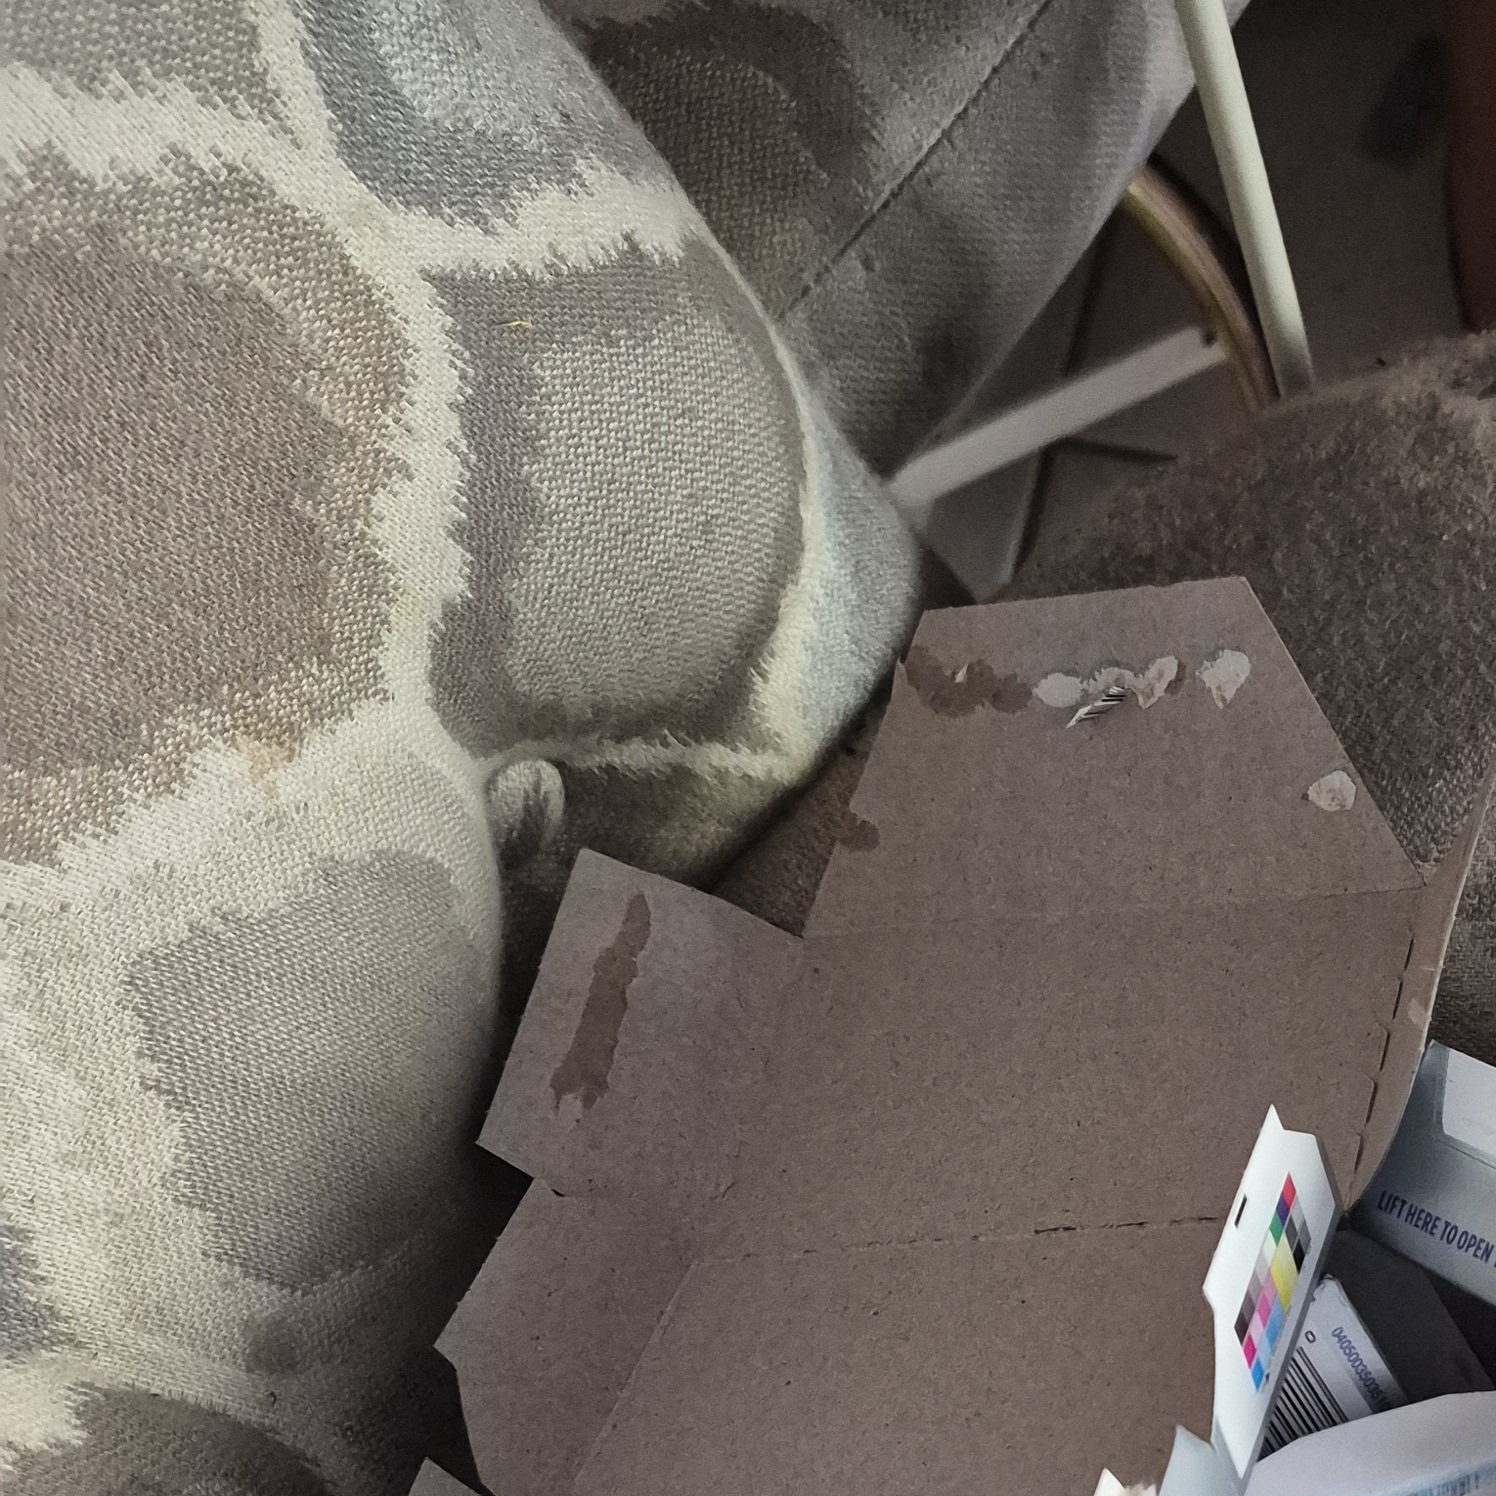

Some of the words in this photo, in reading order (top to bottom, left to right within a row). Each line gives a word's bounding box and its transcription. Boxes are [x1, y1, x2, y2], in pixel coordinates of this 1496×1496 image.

[1375, 1189, 1407, 1219] LIFT
[1402, 1203, 1442, 1236] HERE
[1437, 1220, 1459, 1245] TO
[1454, 1229, 1495, 1263] OPEN
